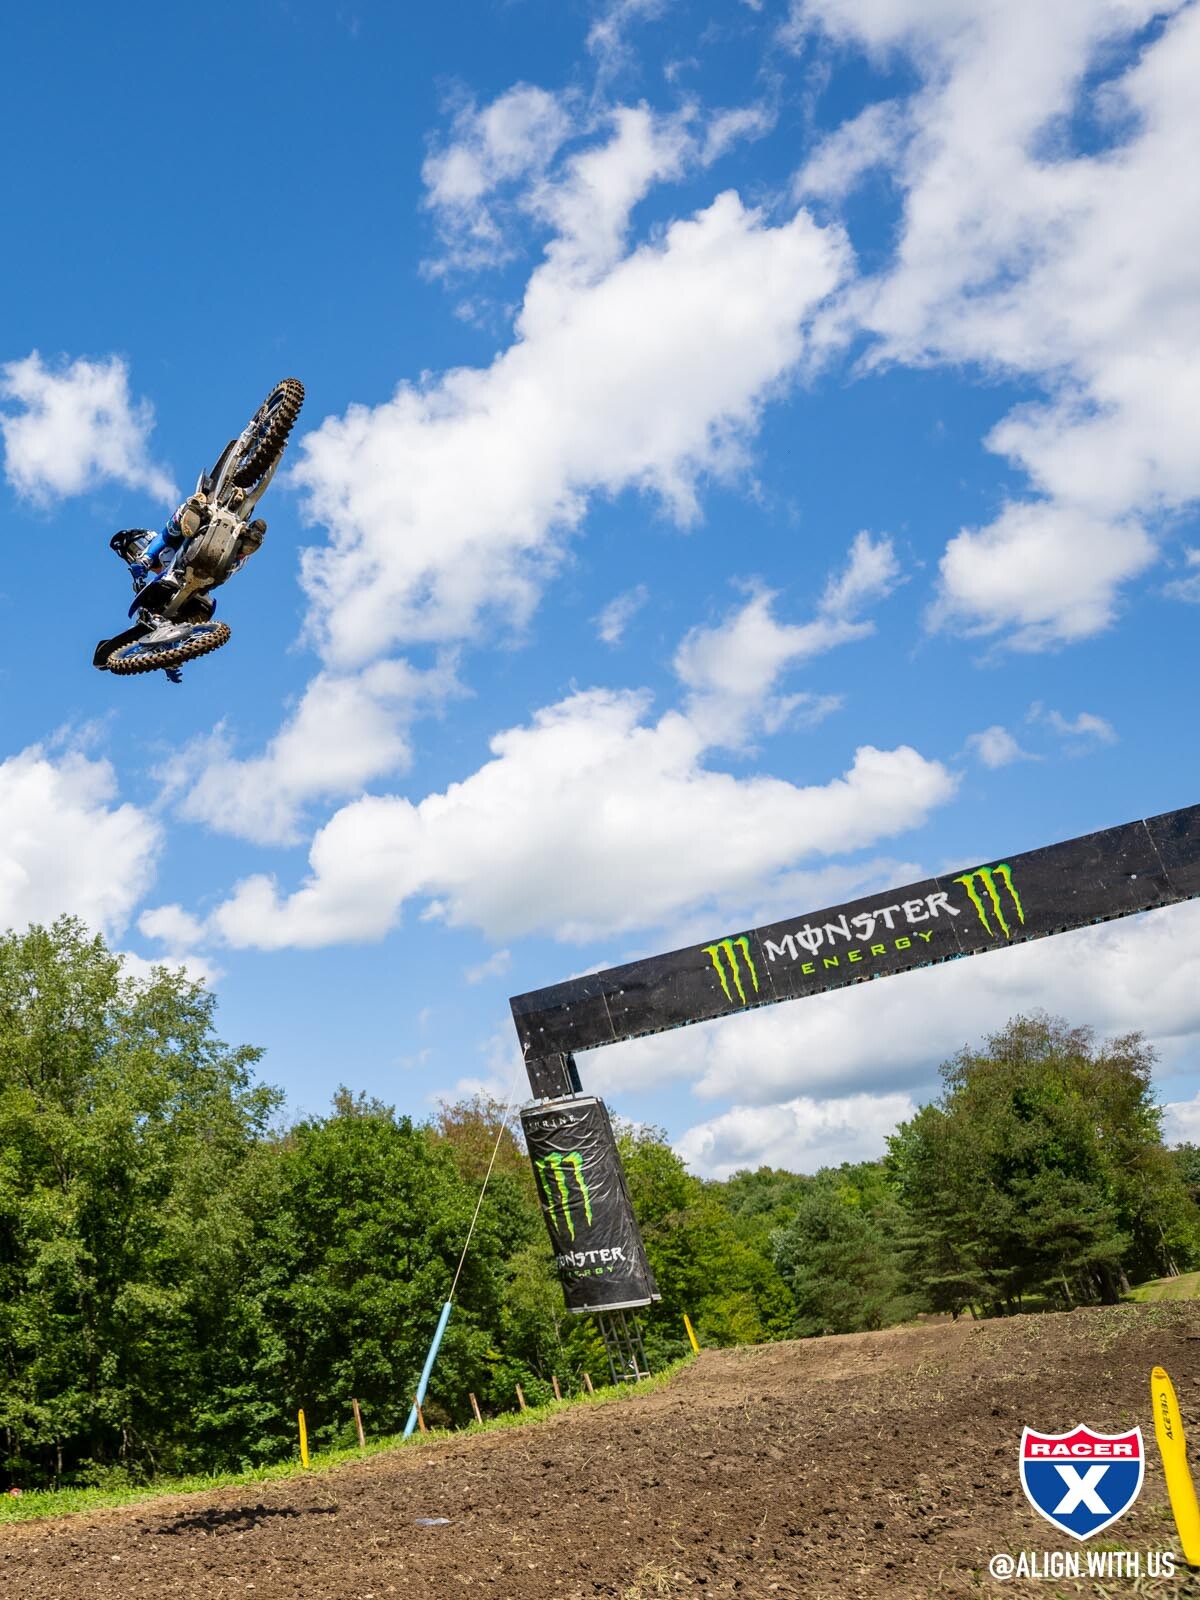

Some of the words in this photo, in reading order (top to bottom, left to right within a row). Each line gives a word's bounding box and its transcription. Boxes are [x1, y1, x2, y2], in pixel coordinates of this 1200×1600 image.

[763, 891, 961, 962] MONSTER
[801, 930, 934, 975] ENERGY
[557, 1246, 627, 1268] ONSTER
[1159, 1392, 1174, 1441] ACERBIS
